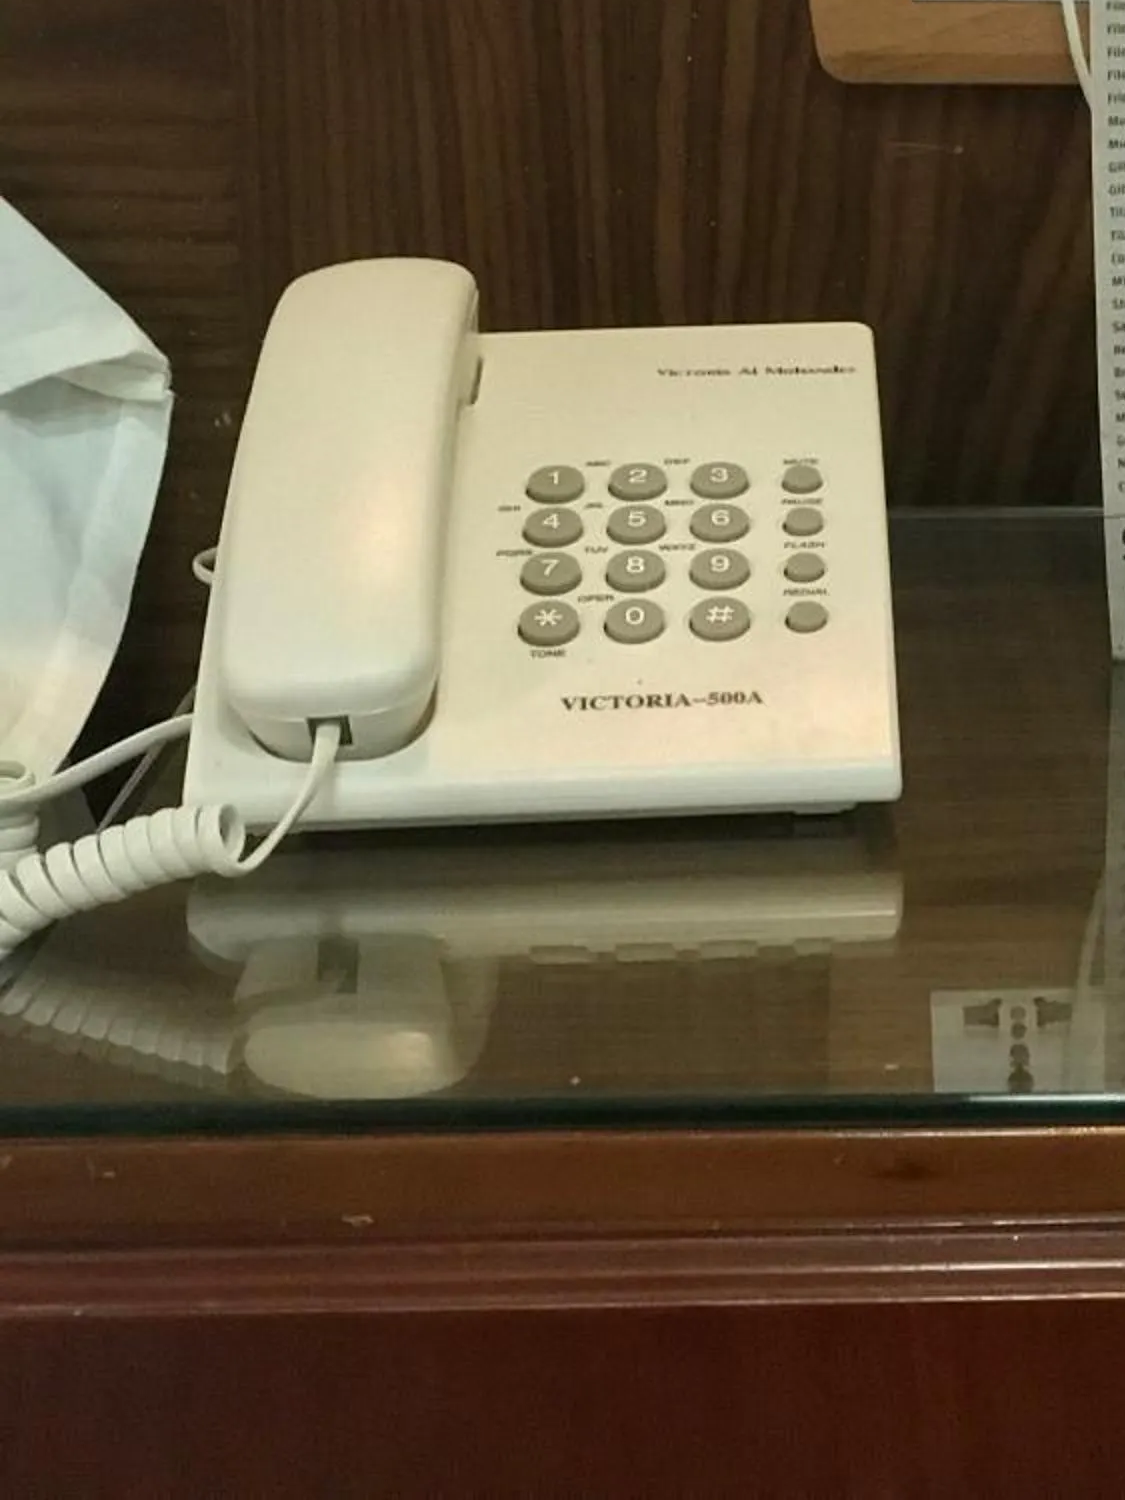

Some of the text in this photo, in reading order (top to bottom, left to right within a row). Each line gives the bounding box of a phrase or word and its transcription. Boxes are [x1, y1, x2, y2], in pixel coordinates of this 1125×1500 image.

[549, 471, 559, 485] 1
[629, 469, 647, 483] 2
[710, 468, 728, 482] 3
[542, 514, 560, 529] 4
[628, 512, 646, 526] 5
[712, 510, 729, 525] 6
[541, 559, 559, 576] 7
[626, 557, 645, 573] 8
[711, 555, 729, 572] 9
